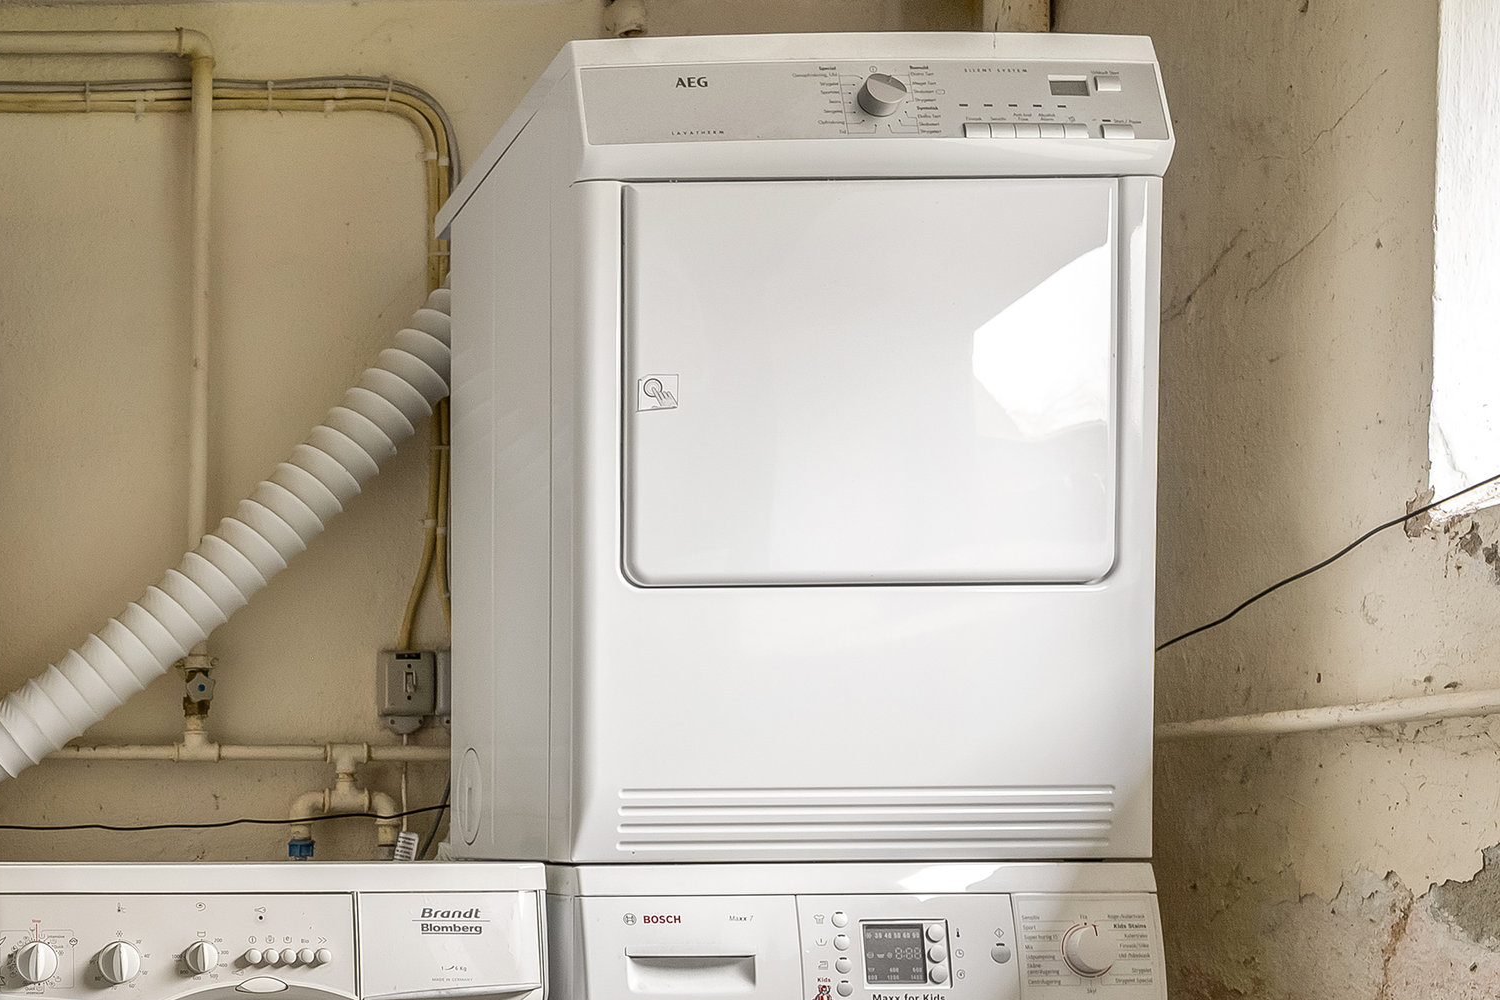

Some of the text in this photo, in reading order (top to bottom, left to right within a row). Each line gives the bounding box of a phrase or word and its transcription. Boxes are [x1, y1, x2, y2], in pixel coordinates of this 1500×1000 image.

[675, 76, 708, 88] AEG
[421, 908, 481, 919] Brandt
[644, 915, 681, 924] BOSCH
[421, 923, 482, 934] Blomberg
